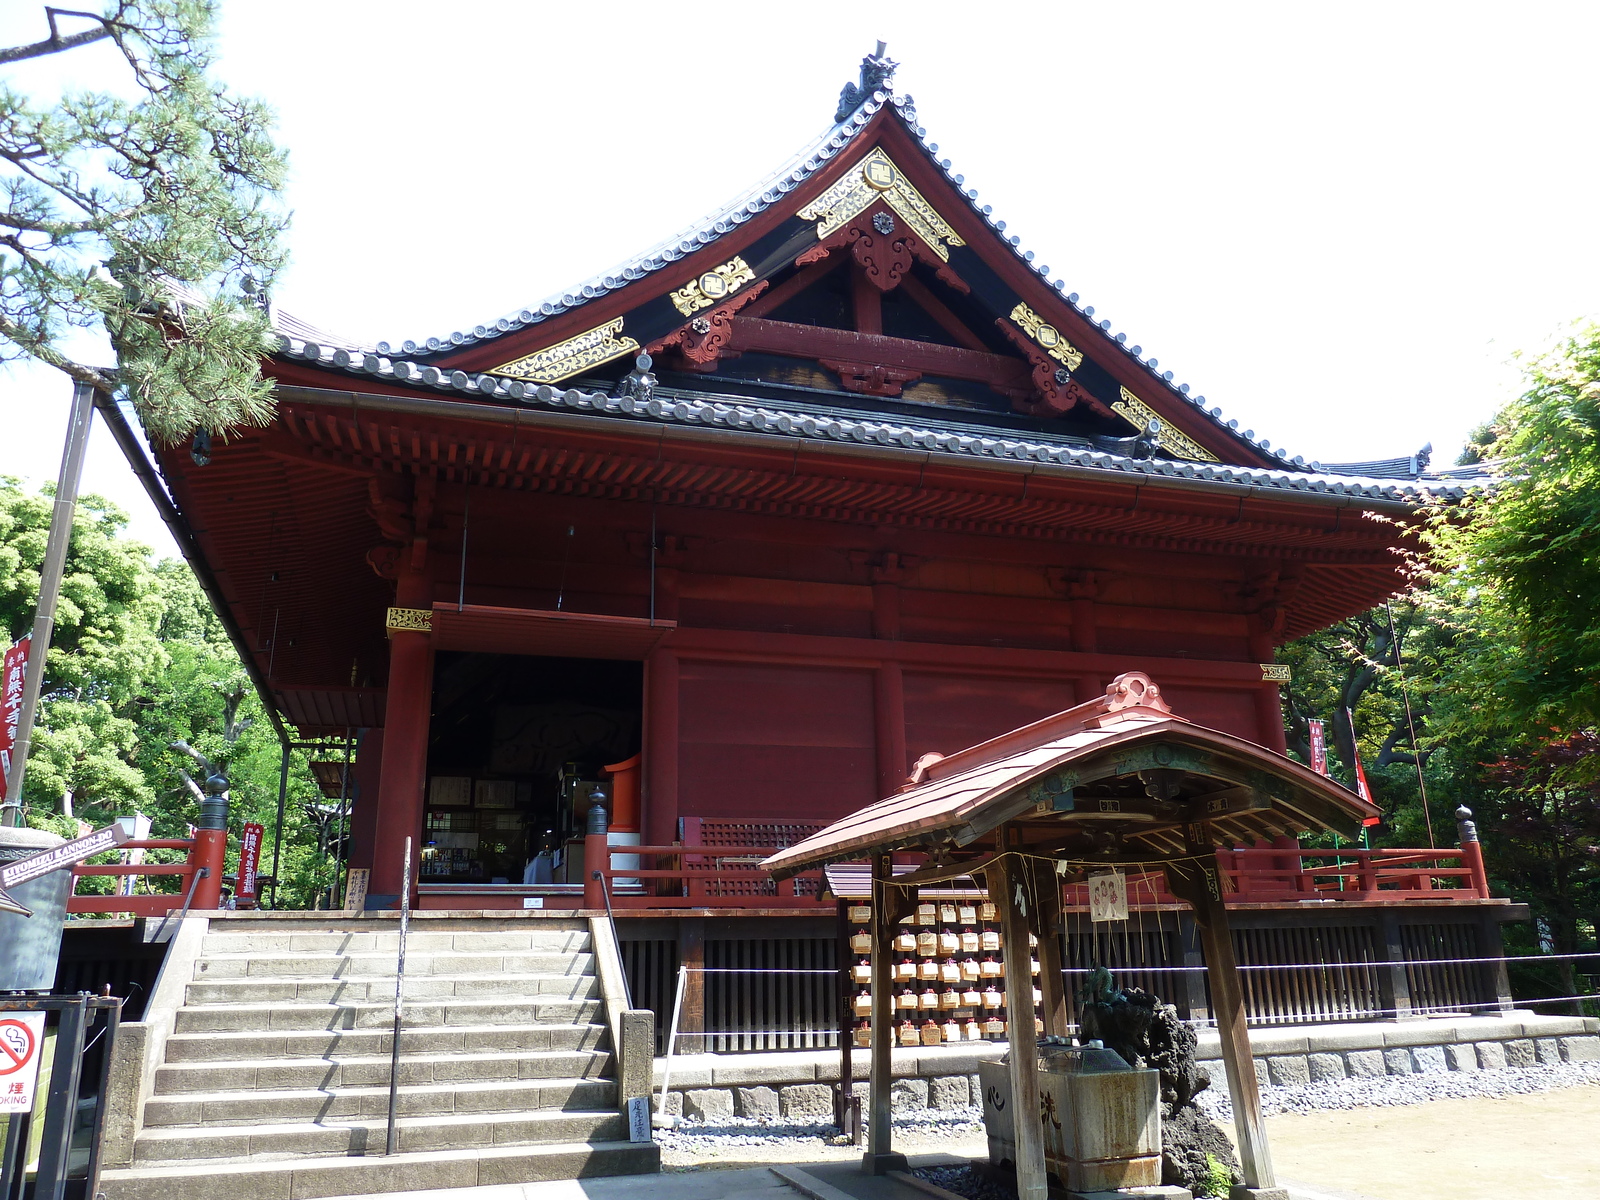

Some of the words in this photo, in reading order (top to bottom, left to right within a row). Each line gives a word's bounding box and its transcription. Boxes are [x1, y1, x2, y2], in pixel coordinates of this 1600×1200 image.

[3, 852, 54, 878] KIYOMIZU
[55, 829, 113, 858] KANNON-DO
[8, 1082, 24, 1094] 煙
[987, 1085, 1006, 1112] 心
